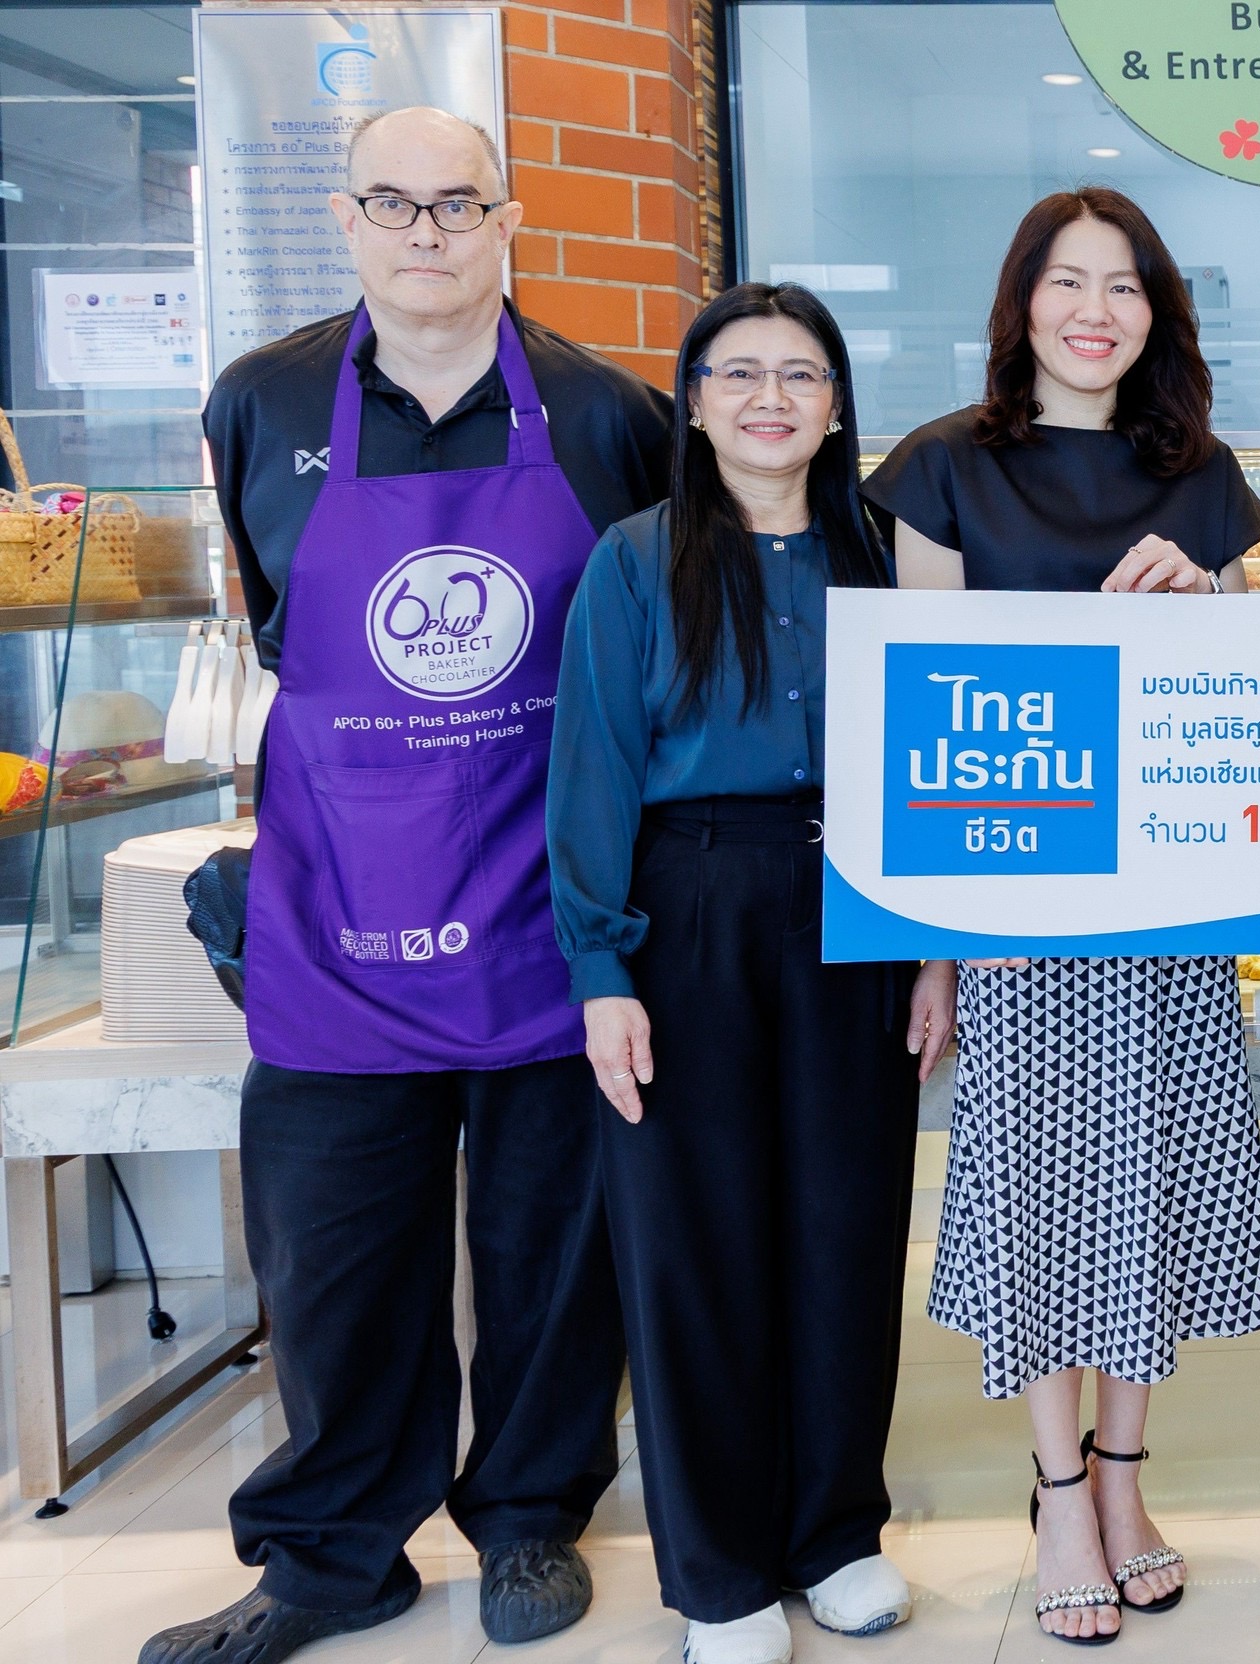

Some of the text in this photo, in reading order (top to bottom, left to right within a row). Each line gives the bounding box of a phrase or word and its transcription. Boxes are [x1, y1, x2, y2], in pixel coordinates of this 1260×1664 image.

[1121, 50, 1150, 80] &
[337, 97, 388, 107] Foundation
[226, 138, 276, 153] โครงการ
[304, 141, 329, 152] Plus
[334, 141, 350, 152] Ba
[234, 161, 349, 175] กระทรวงการพัฒนาสังค
[235, 182, 350, 195] กรมส่งเสริมและพัฒนา
[236, 206, 327, 217] Embassy of Japan
[237, 226, 257, 236] Thai
[261, 226, 309, 236] Yamazaki
[237, 246, 278, 256] MarkRin
[282, 246, 332, 256] Chocolate
[421, 613, 484, 637] PLUS
[404, 635, 493, 658] PROJECT
[428, 656, 476, 671] BAKERY
[411, 666, 496, 685] CHOCOLATIER
[926, 671, 1054, 732] ไทย
[333, 695, 558, 730] APCD 60+ Plus Bakery & Choc
[1142, 713, 1172, 739] แก่
[404, 724, 524, 750] Training House
[908, 736, 1095, 790] ประกัน
[965, 816, 1039, 853] ชีวิต
[1139, 812, 1226, 843] จำนวน
[340, 928, 387, 941] MAE FROM
[340, 936, 389, 952] RECCLED
[355, 950, 390, 960] BOTTLES
